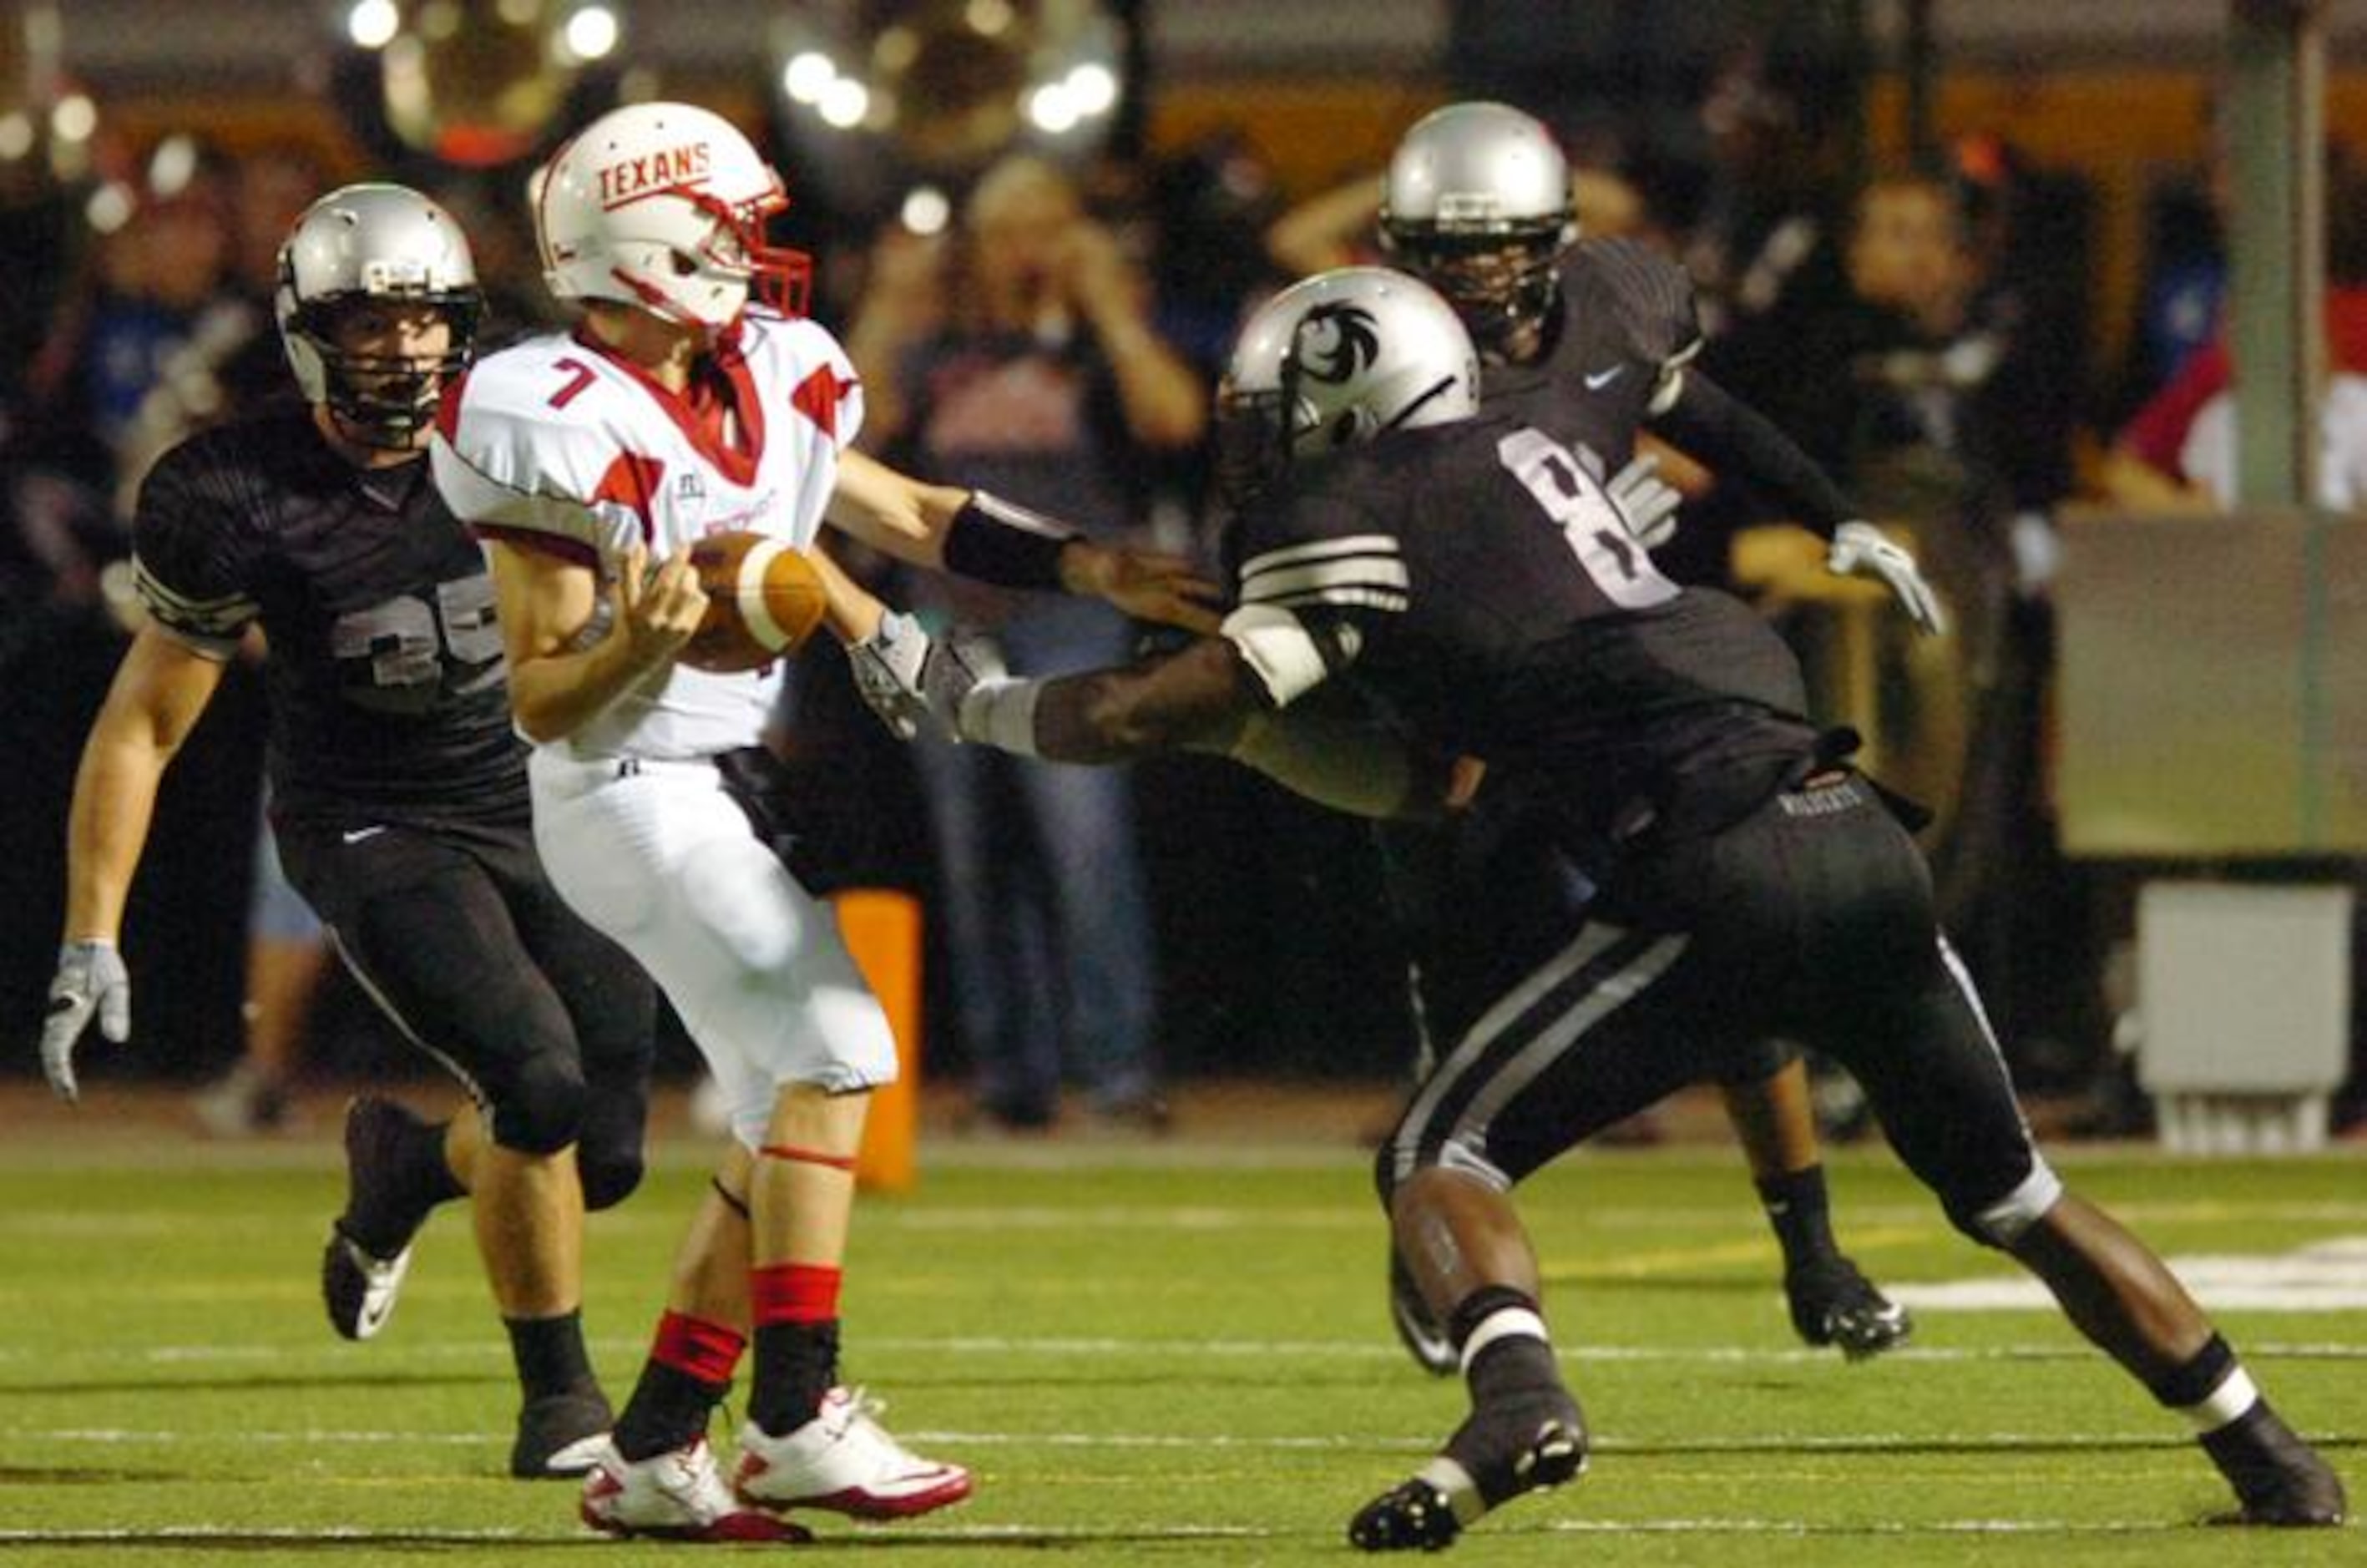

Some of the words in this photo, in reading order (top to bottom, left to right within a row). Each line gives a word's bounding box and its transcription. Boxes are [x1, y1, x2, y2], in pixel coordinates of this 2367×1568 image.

[598, 141, 711, 200] TEXANS
[547, 357, 598, 411] 7
[1497, 425, 1682, 609] 8
